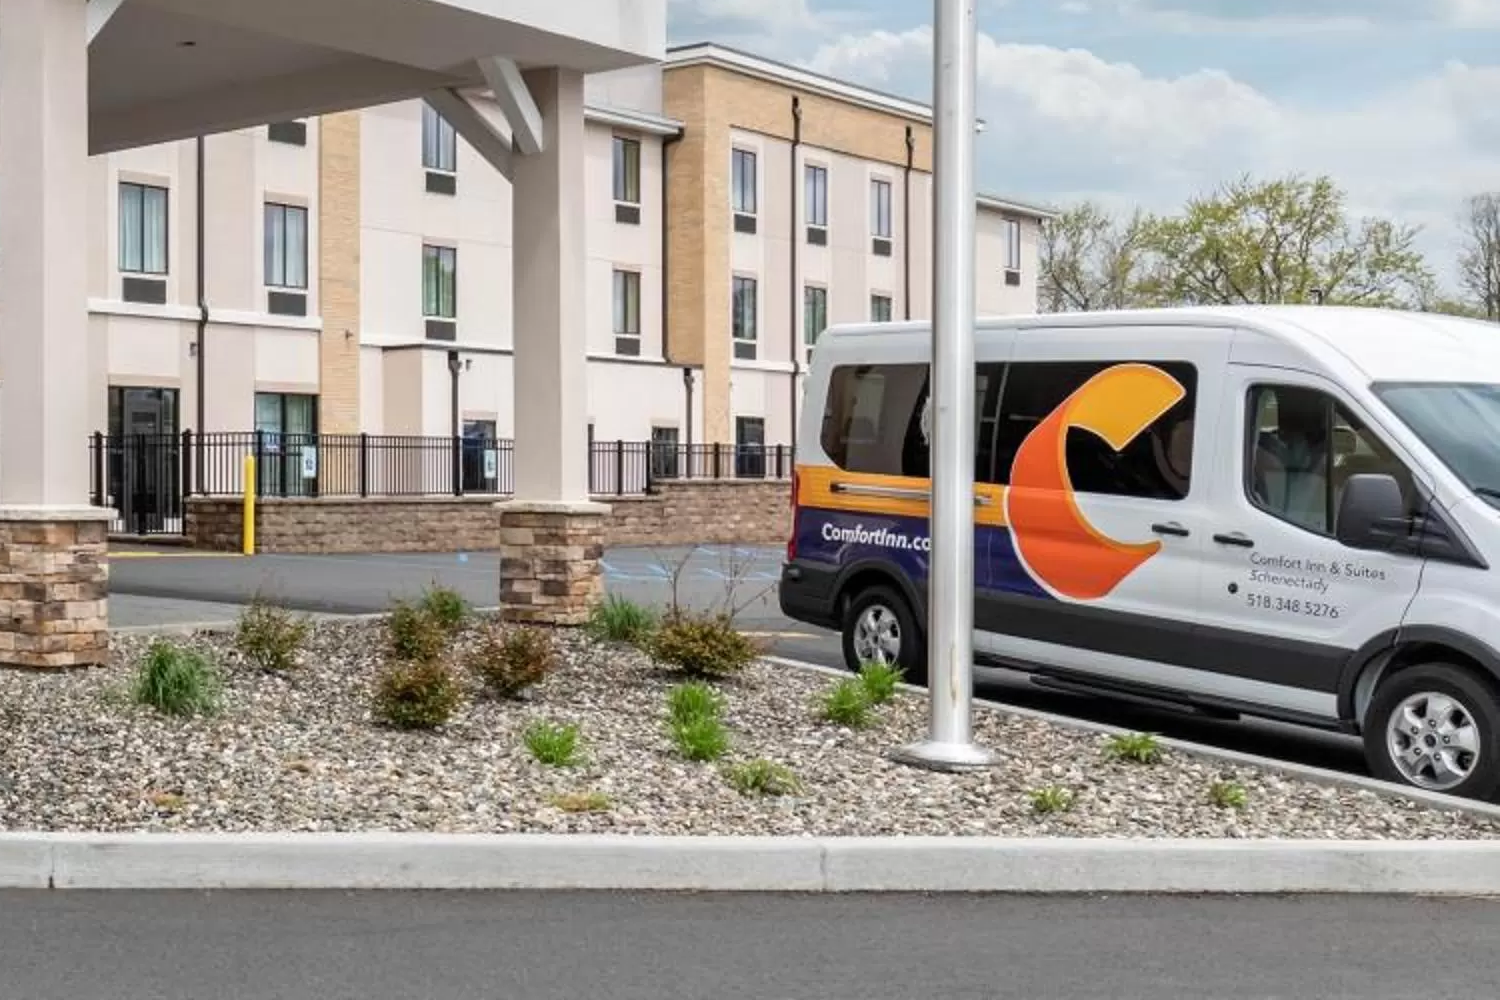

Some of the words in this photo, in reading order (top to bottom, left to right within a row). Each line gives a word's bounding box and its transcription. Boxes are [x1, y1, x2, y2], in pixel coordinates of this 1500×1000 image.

[1250, 551, 1301, 570] Comfort
[1306, 558, 1325, 573] Inn
[1330, 561, 1341, 574] &
[1345, 563, 1386, 580] Suites
[1248, 570, 1330, 595] Schenectady
